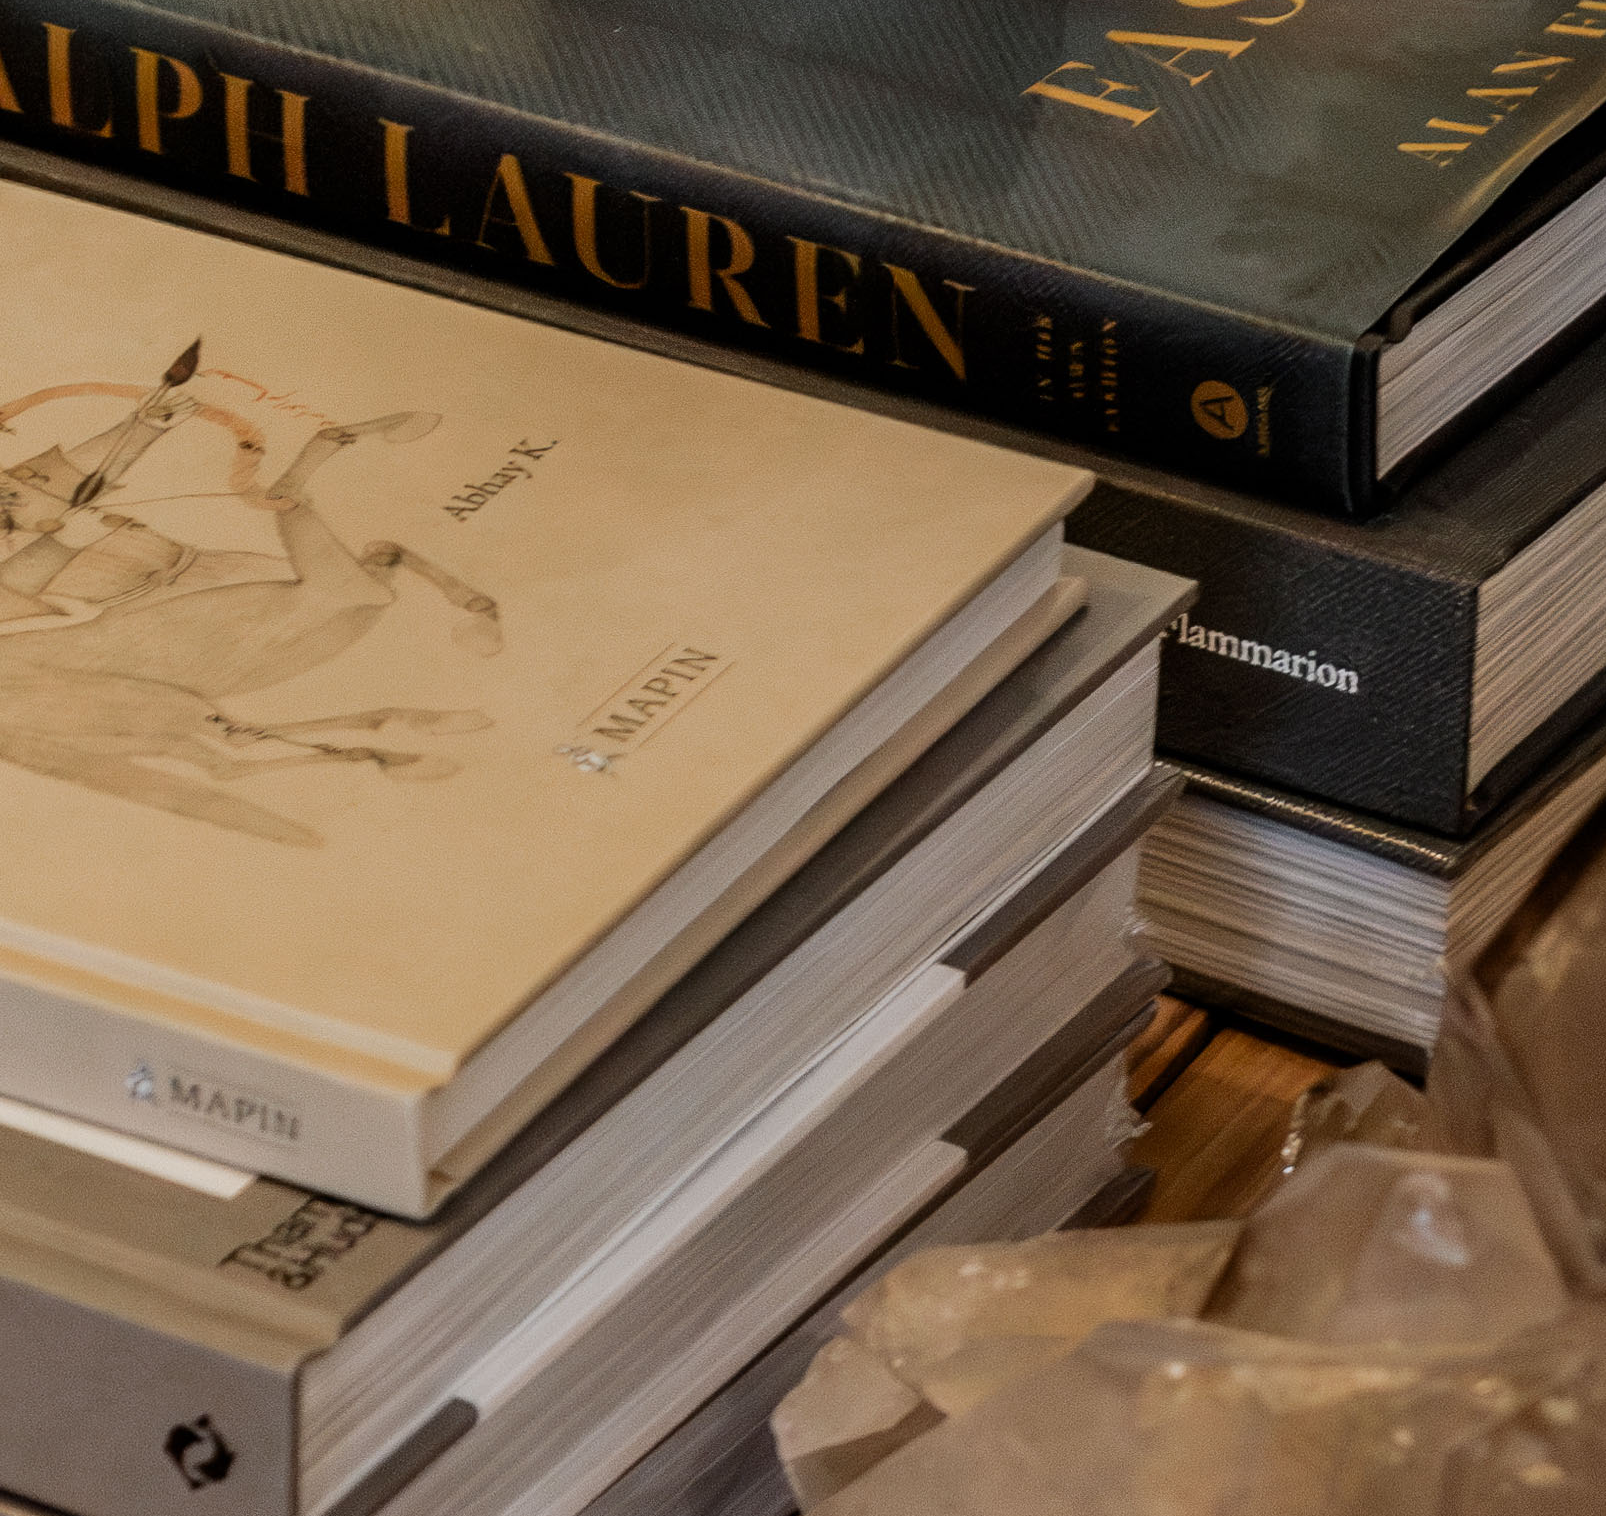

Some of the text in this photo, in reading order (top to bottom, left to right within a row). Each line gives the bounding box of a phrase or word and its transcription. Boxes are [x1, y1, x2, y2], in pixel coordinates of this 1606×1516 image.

[1397, 49, 1576, 168] ALAN
[378, 116, 976, 383] LAUREN
[443, 460, 533, 522] Abhay
[593, 647, 719, 743] MAPIN
[1158, 612, 1361, 695] lammarion
[169, 1076, 301, 1142] MAPIN
